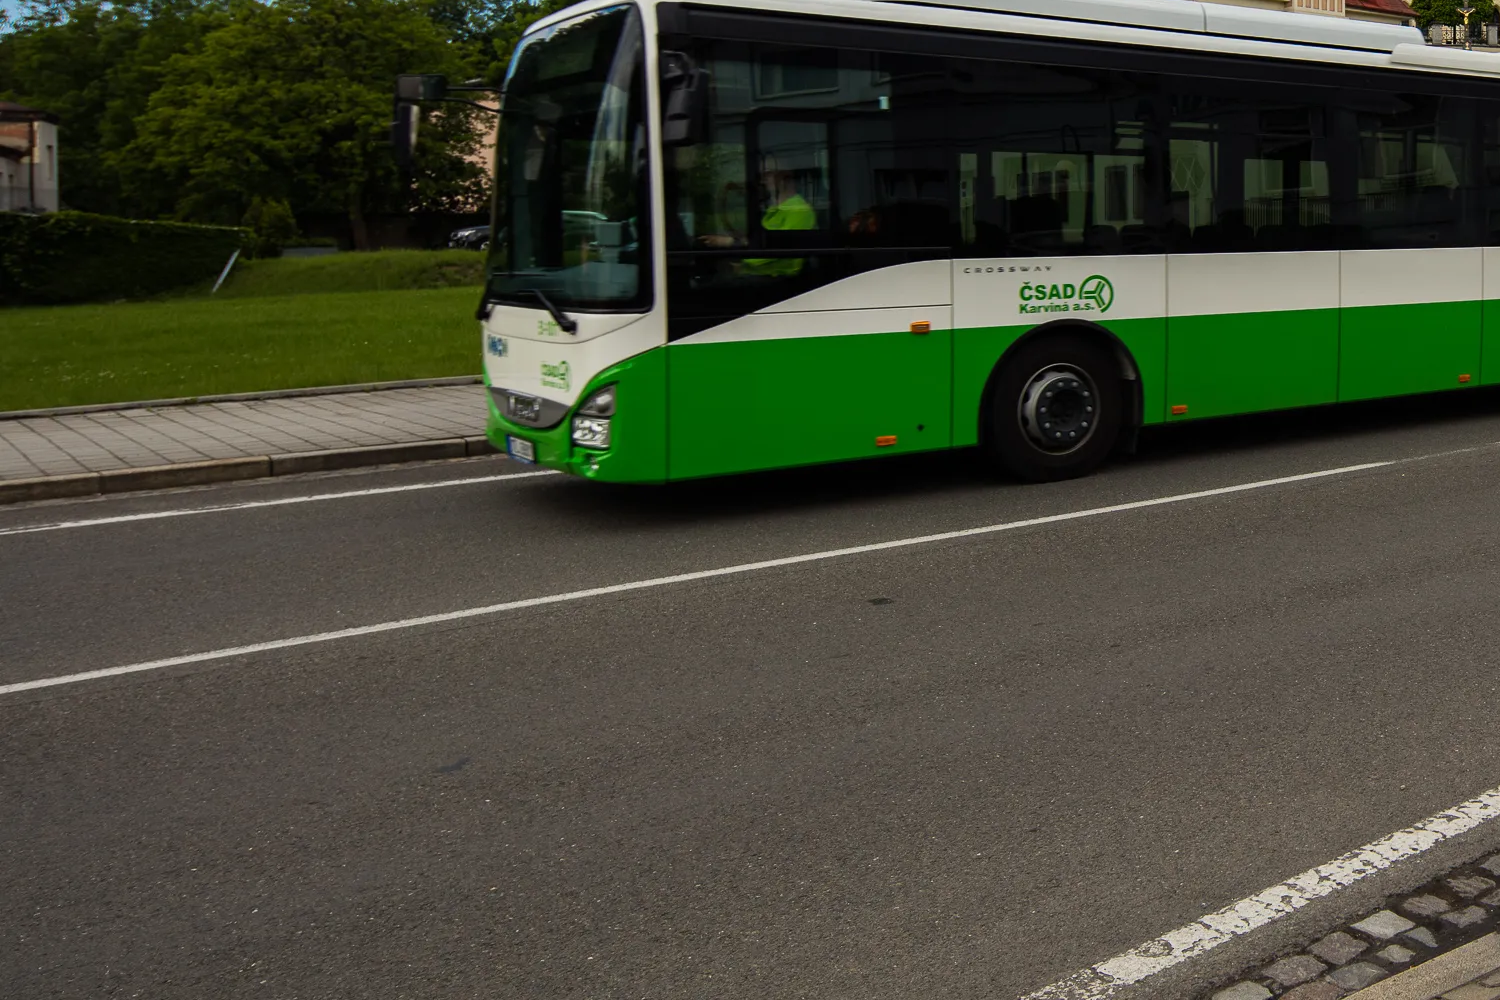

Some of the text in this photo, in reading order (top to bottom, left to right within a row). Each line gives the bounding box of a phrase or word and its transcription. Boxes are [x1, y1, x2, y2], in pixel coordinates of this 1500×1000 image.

[963, 265, 1052, 274] CROSSWAY
[1019, 281, 1075, 301] ČSAD
[1019, 302, 1095, 314] Karviná a.s.
